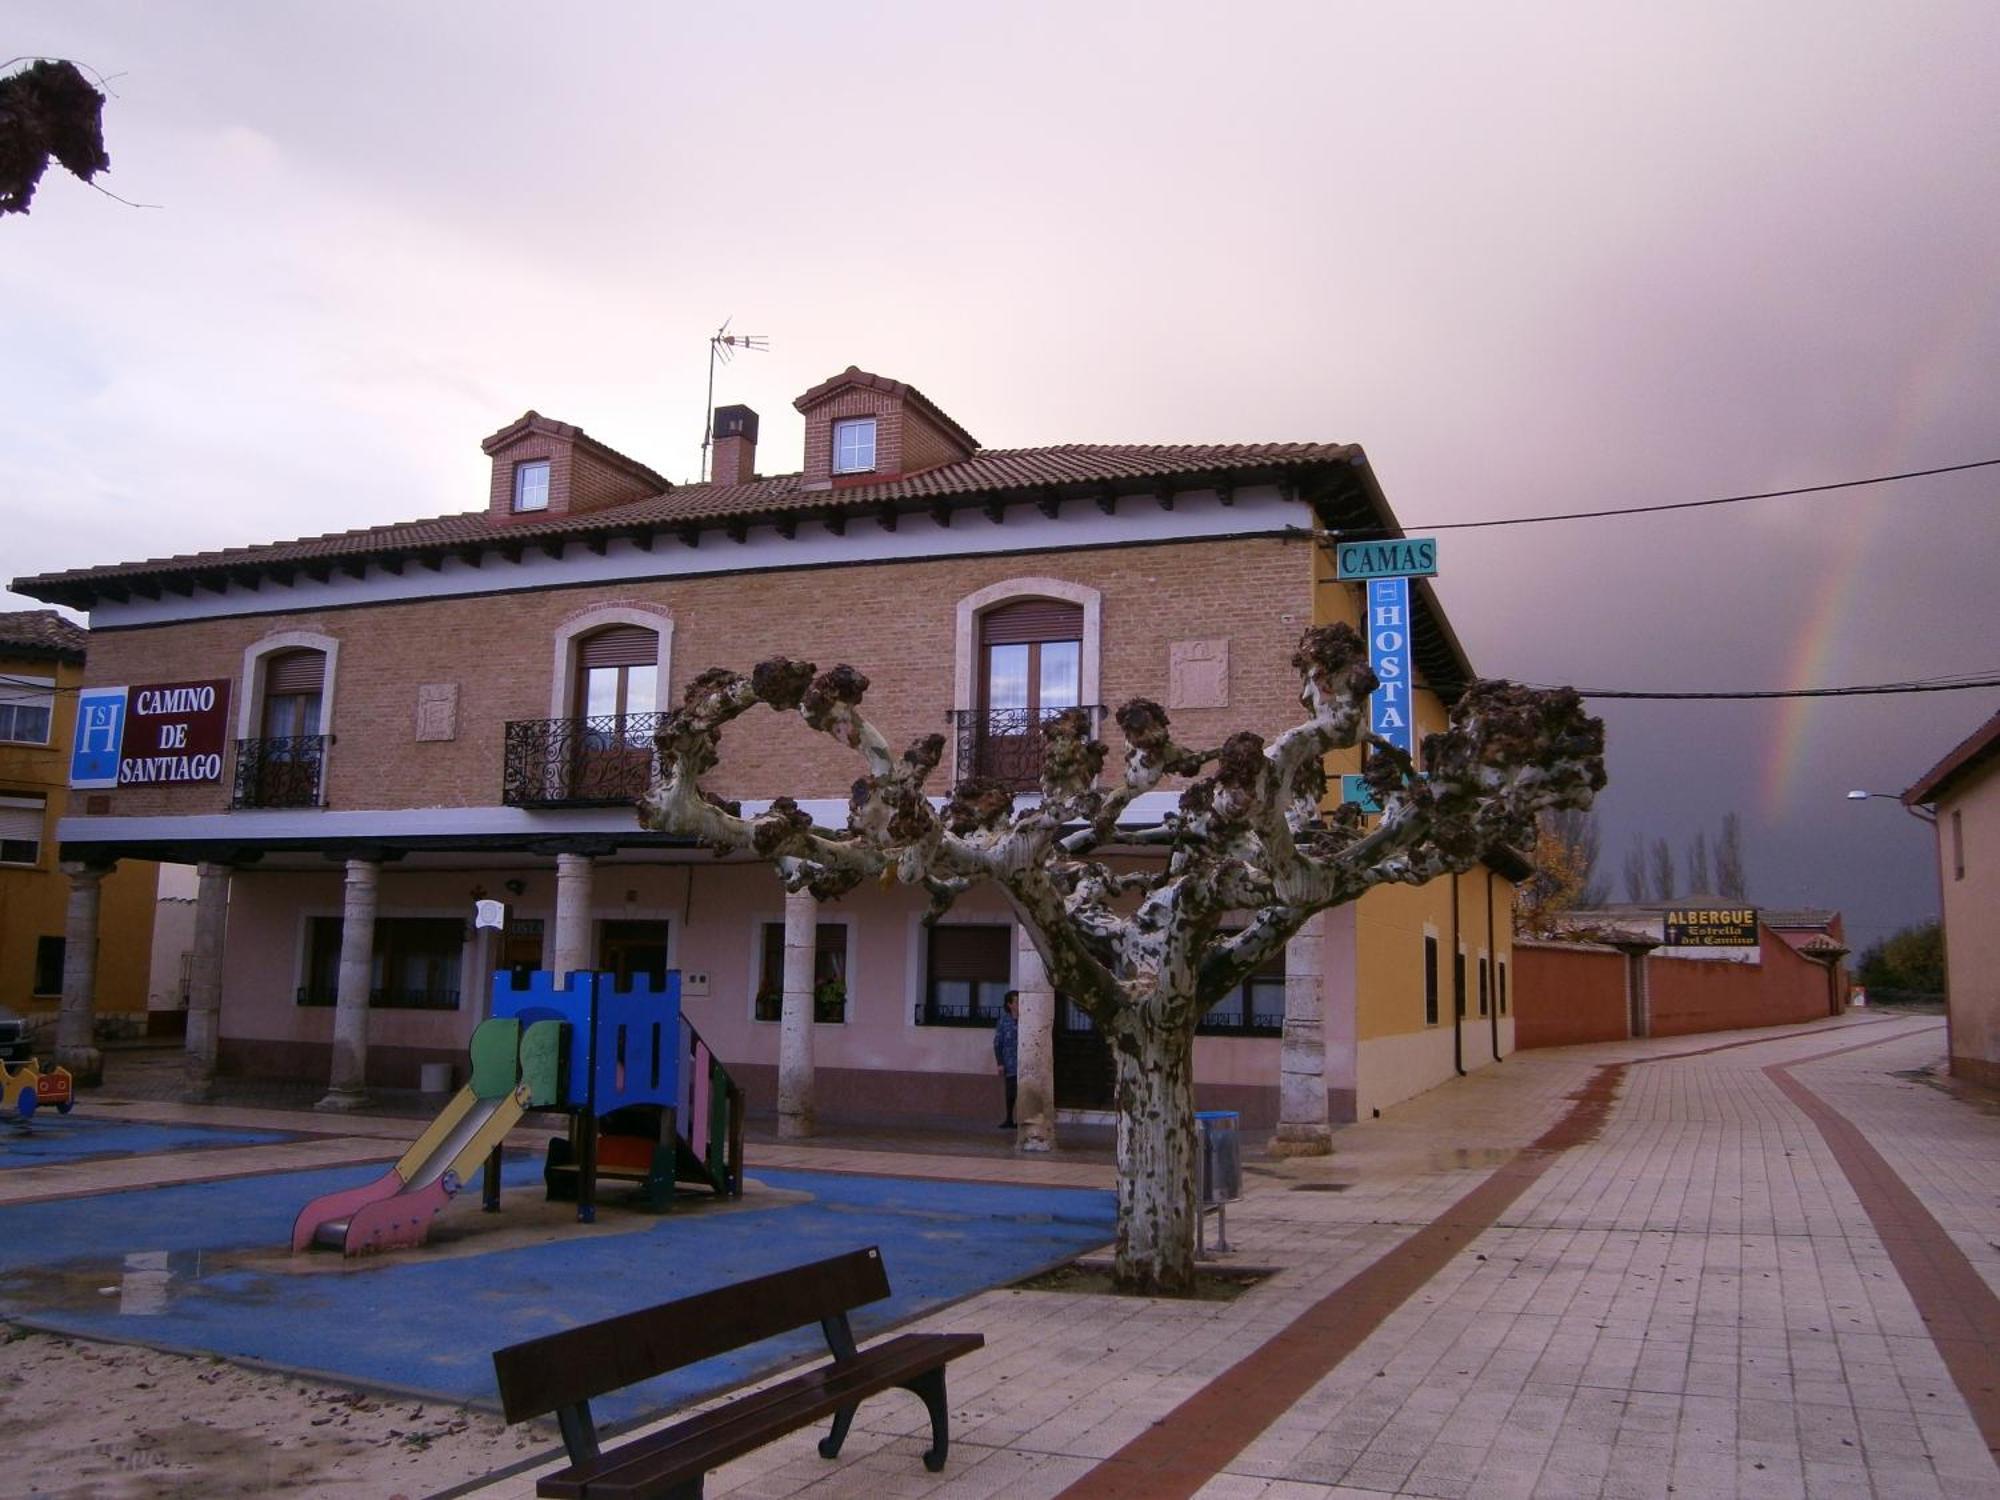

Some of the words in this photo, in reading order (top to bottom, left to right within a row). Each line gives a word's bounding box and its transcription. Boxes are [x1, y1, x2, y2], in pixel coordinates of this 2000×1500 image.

[1341, 543, 1433, 574] CAMAS
[137, 686, 215, 716] CAMINO
[159, 723, 189, 749] DE
[120, 753, 221, 784] SANTIAGO
[1668, 911, 1753, 924] ALBERGUE
[1688, 926, 1741, 935] Estrella
